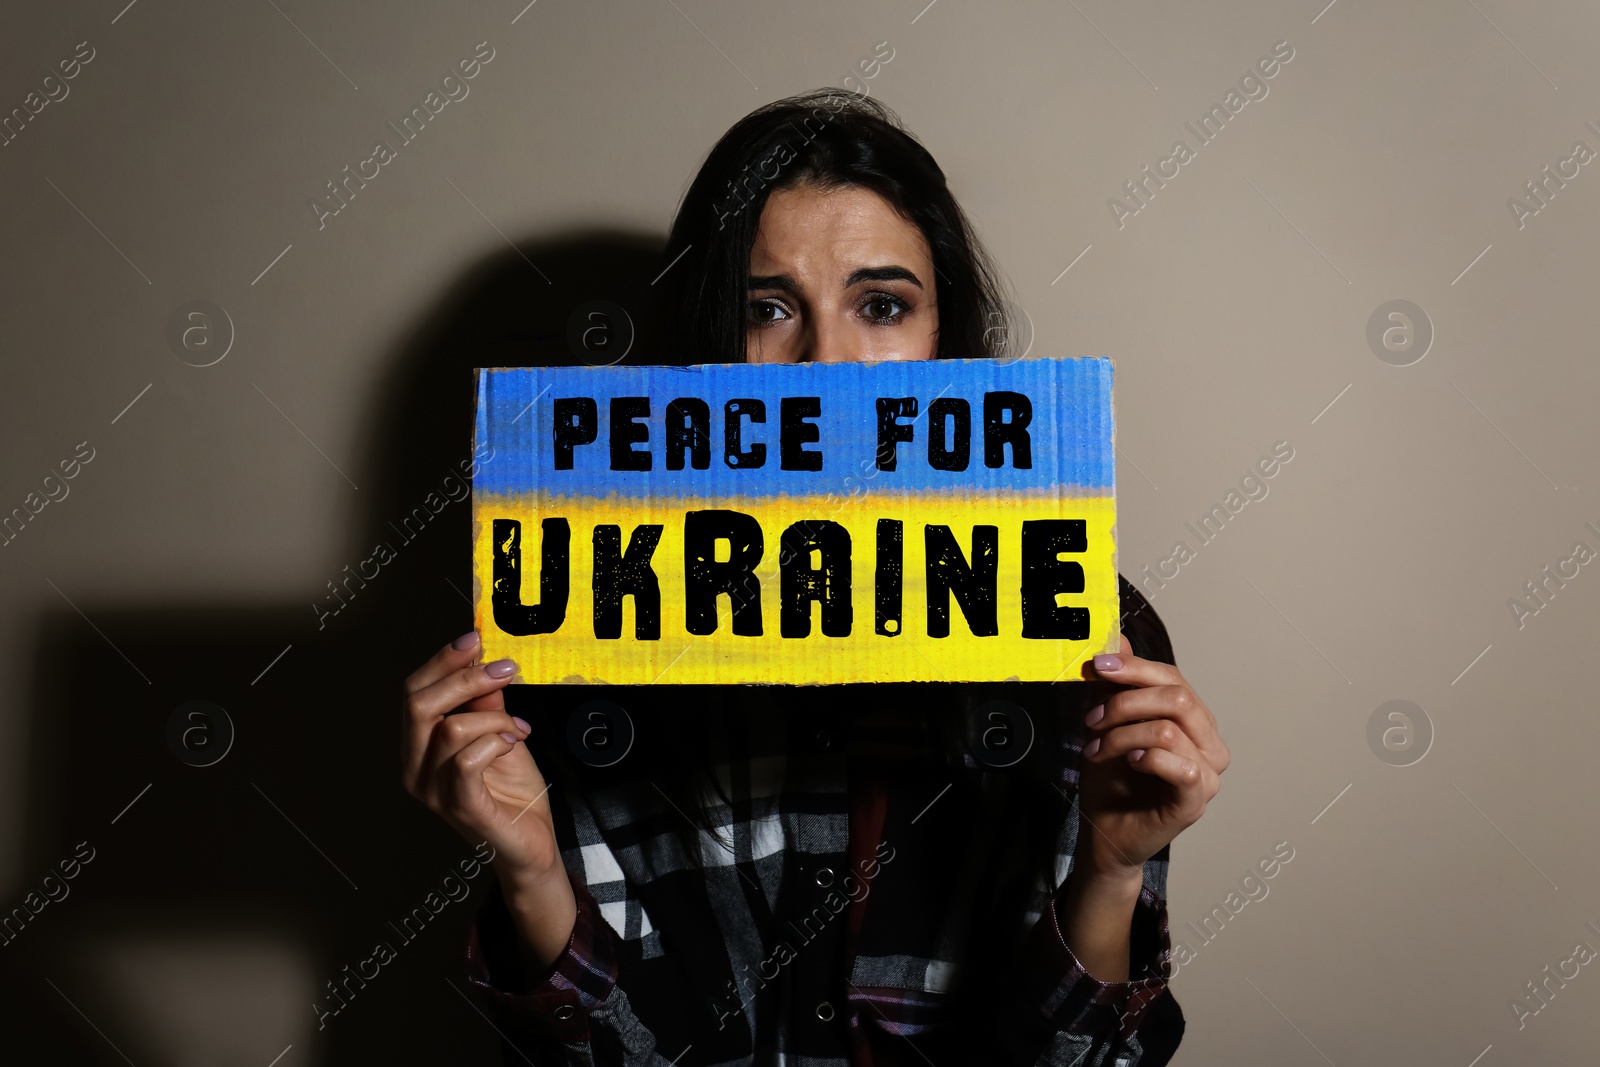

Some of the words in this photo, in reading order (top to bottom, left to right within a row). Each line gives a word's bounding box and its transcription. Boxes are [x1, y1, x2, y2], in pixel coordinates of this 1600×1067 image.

[554, 397, 822, 471] PEACE
[876, 392, 1032, 471] FOR
[492, 510, 1090, 640] UKRAINE
